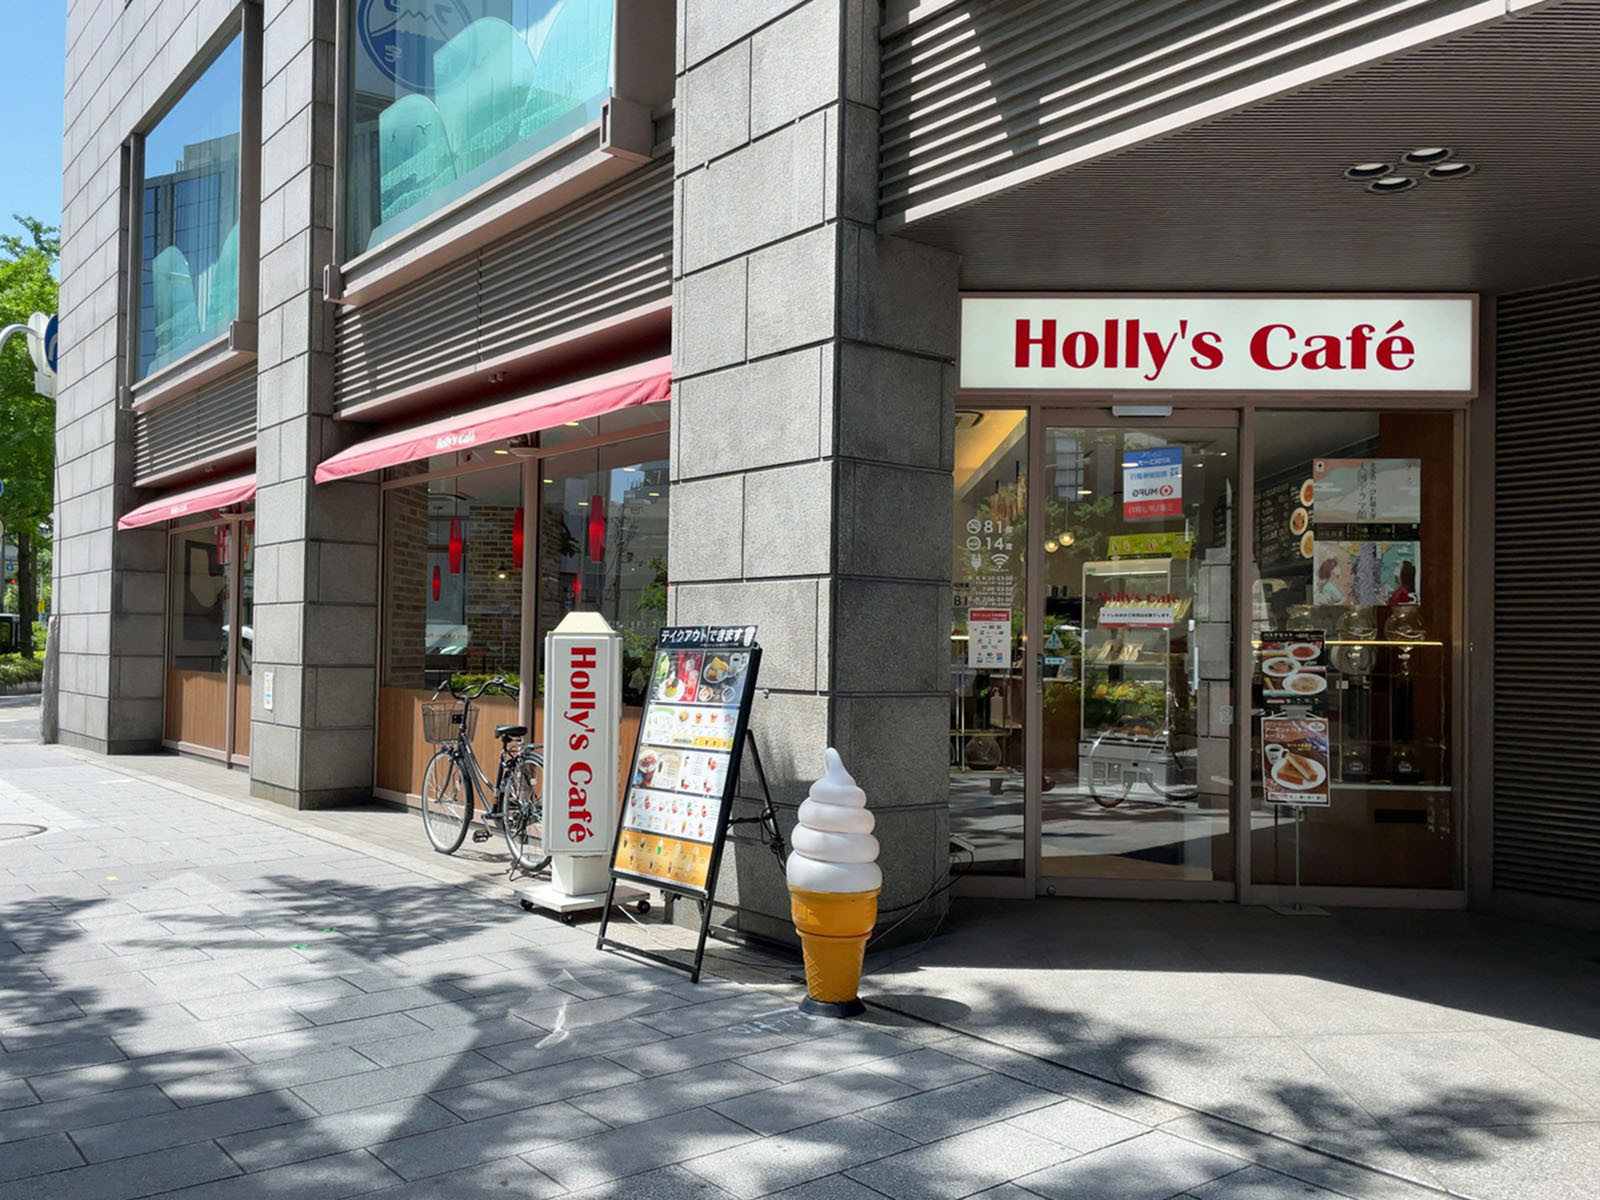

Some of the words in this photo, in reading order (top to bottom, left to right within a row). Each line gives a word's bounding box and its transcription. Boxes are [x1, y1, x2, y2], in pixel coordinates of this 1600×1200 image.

[1014, 319, 1225, 382] Holly's
[1250, 319, 1416, 371] Café
[564, 647, 597, 751] Holly's
[567, 761, 595, 843] Café
